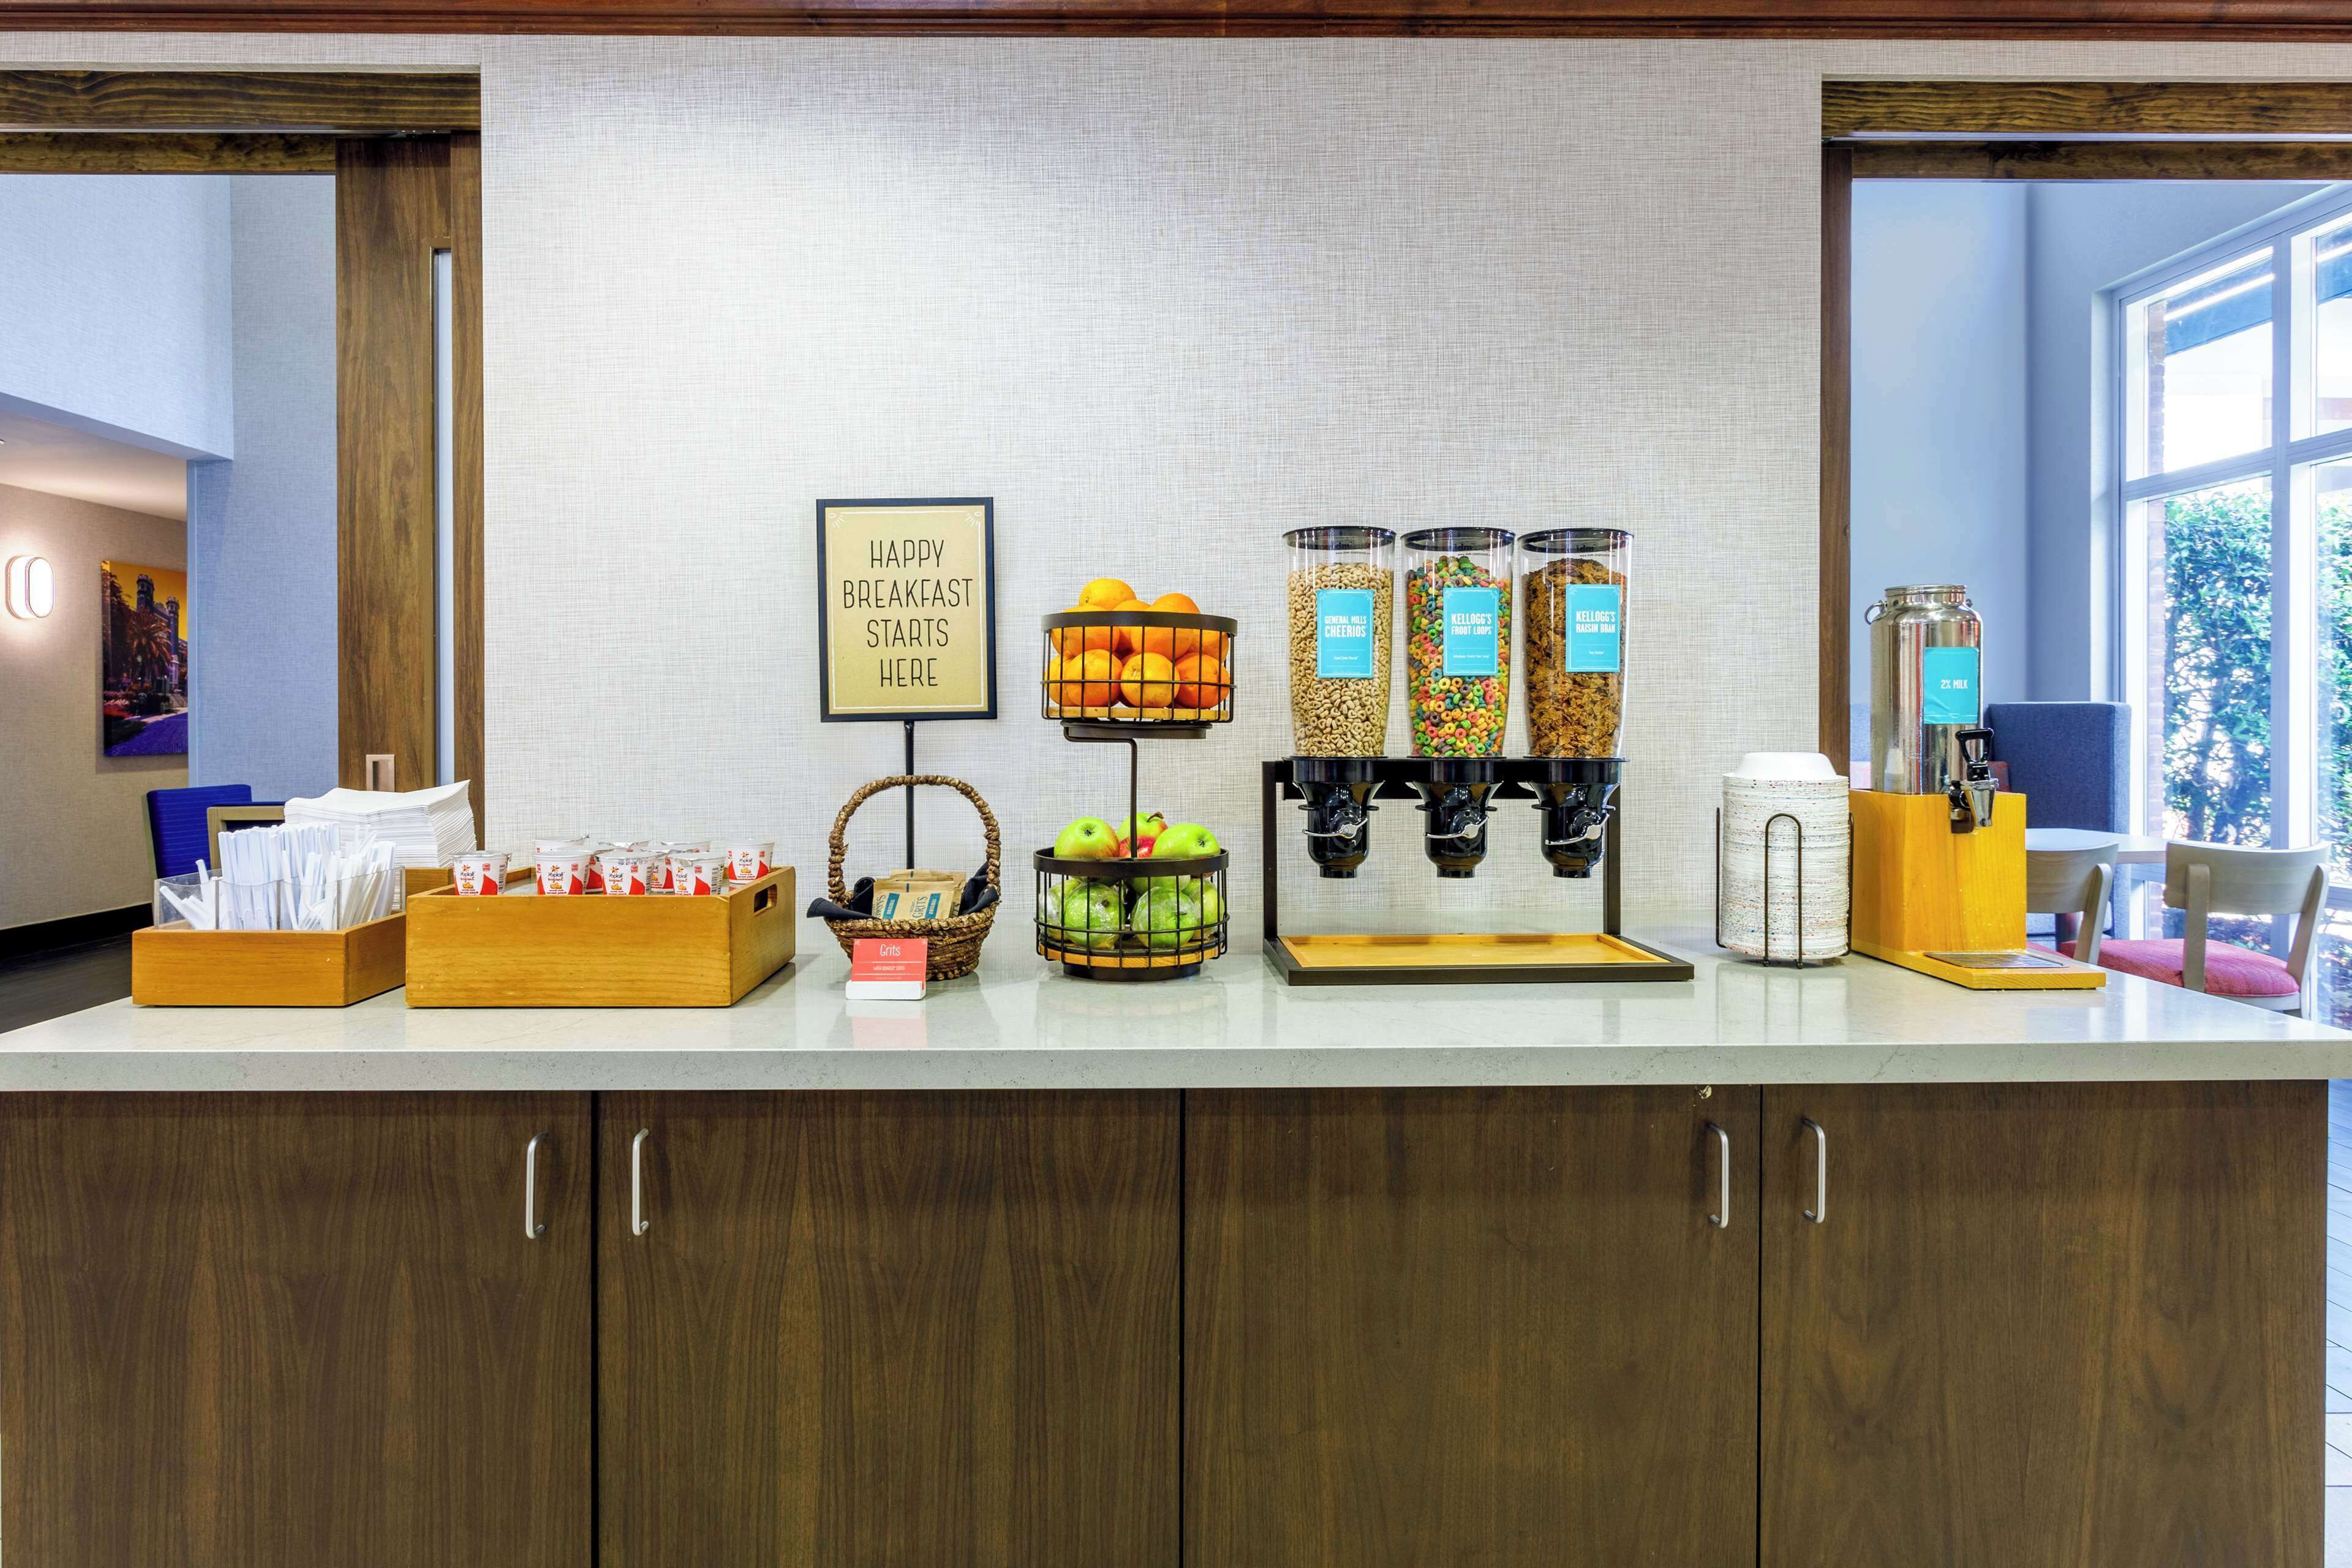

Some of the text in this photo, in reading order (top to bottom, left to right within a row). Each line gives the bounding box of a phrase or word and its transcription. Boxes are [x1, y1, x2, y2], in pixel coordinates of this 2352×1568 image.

[870, 539, 944, 568] HAPPY
[843, 578, 973, 609] BREAKFAST
[1325, 616, 1367, 624] GENERAL MILLS
[1452, 613, 1492, 625] KELLOGG'S
[1576, 611, 1615, 622] KELLOGG'S
[867, 618, 949, 648] STARTS
[1325, 625, 1366, 638] CHEERIOS
[1452, 626, 1492, 635] FROOT LOOPS
[1576, 624, 1616, 633] RAISIN BRAN
[880, 658, 938, 688] HERE
[1940, 679, 1969, 689] 2% MILK
[912, 896, 928, 918] GRITS
[880, 944, 901, 957] Grits
